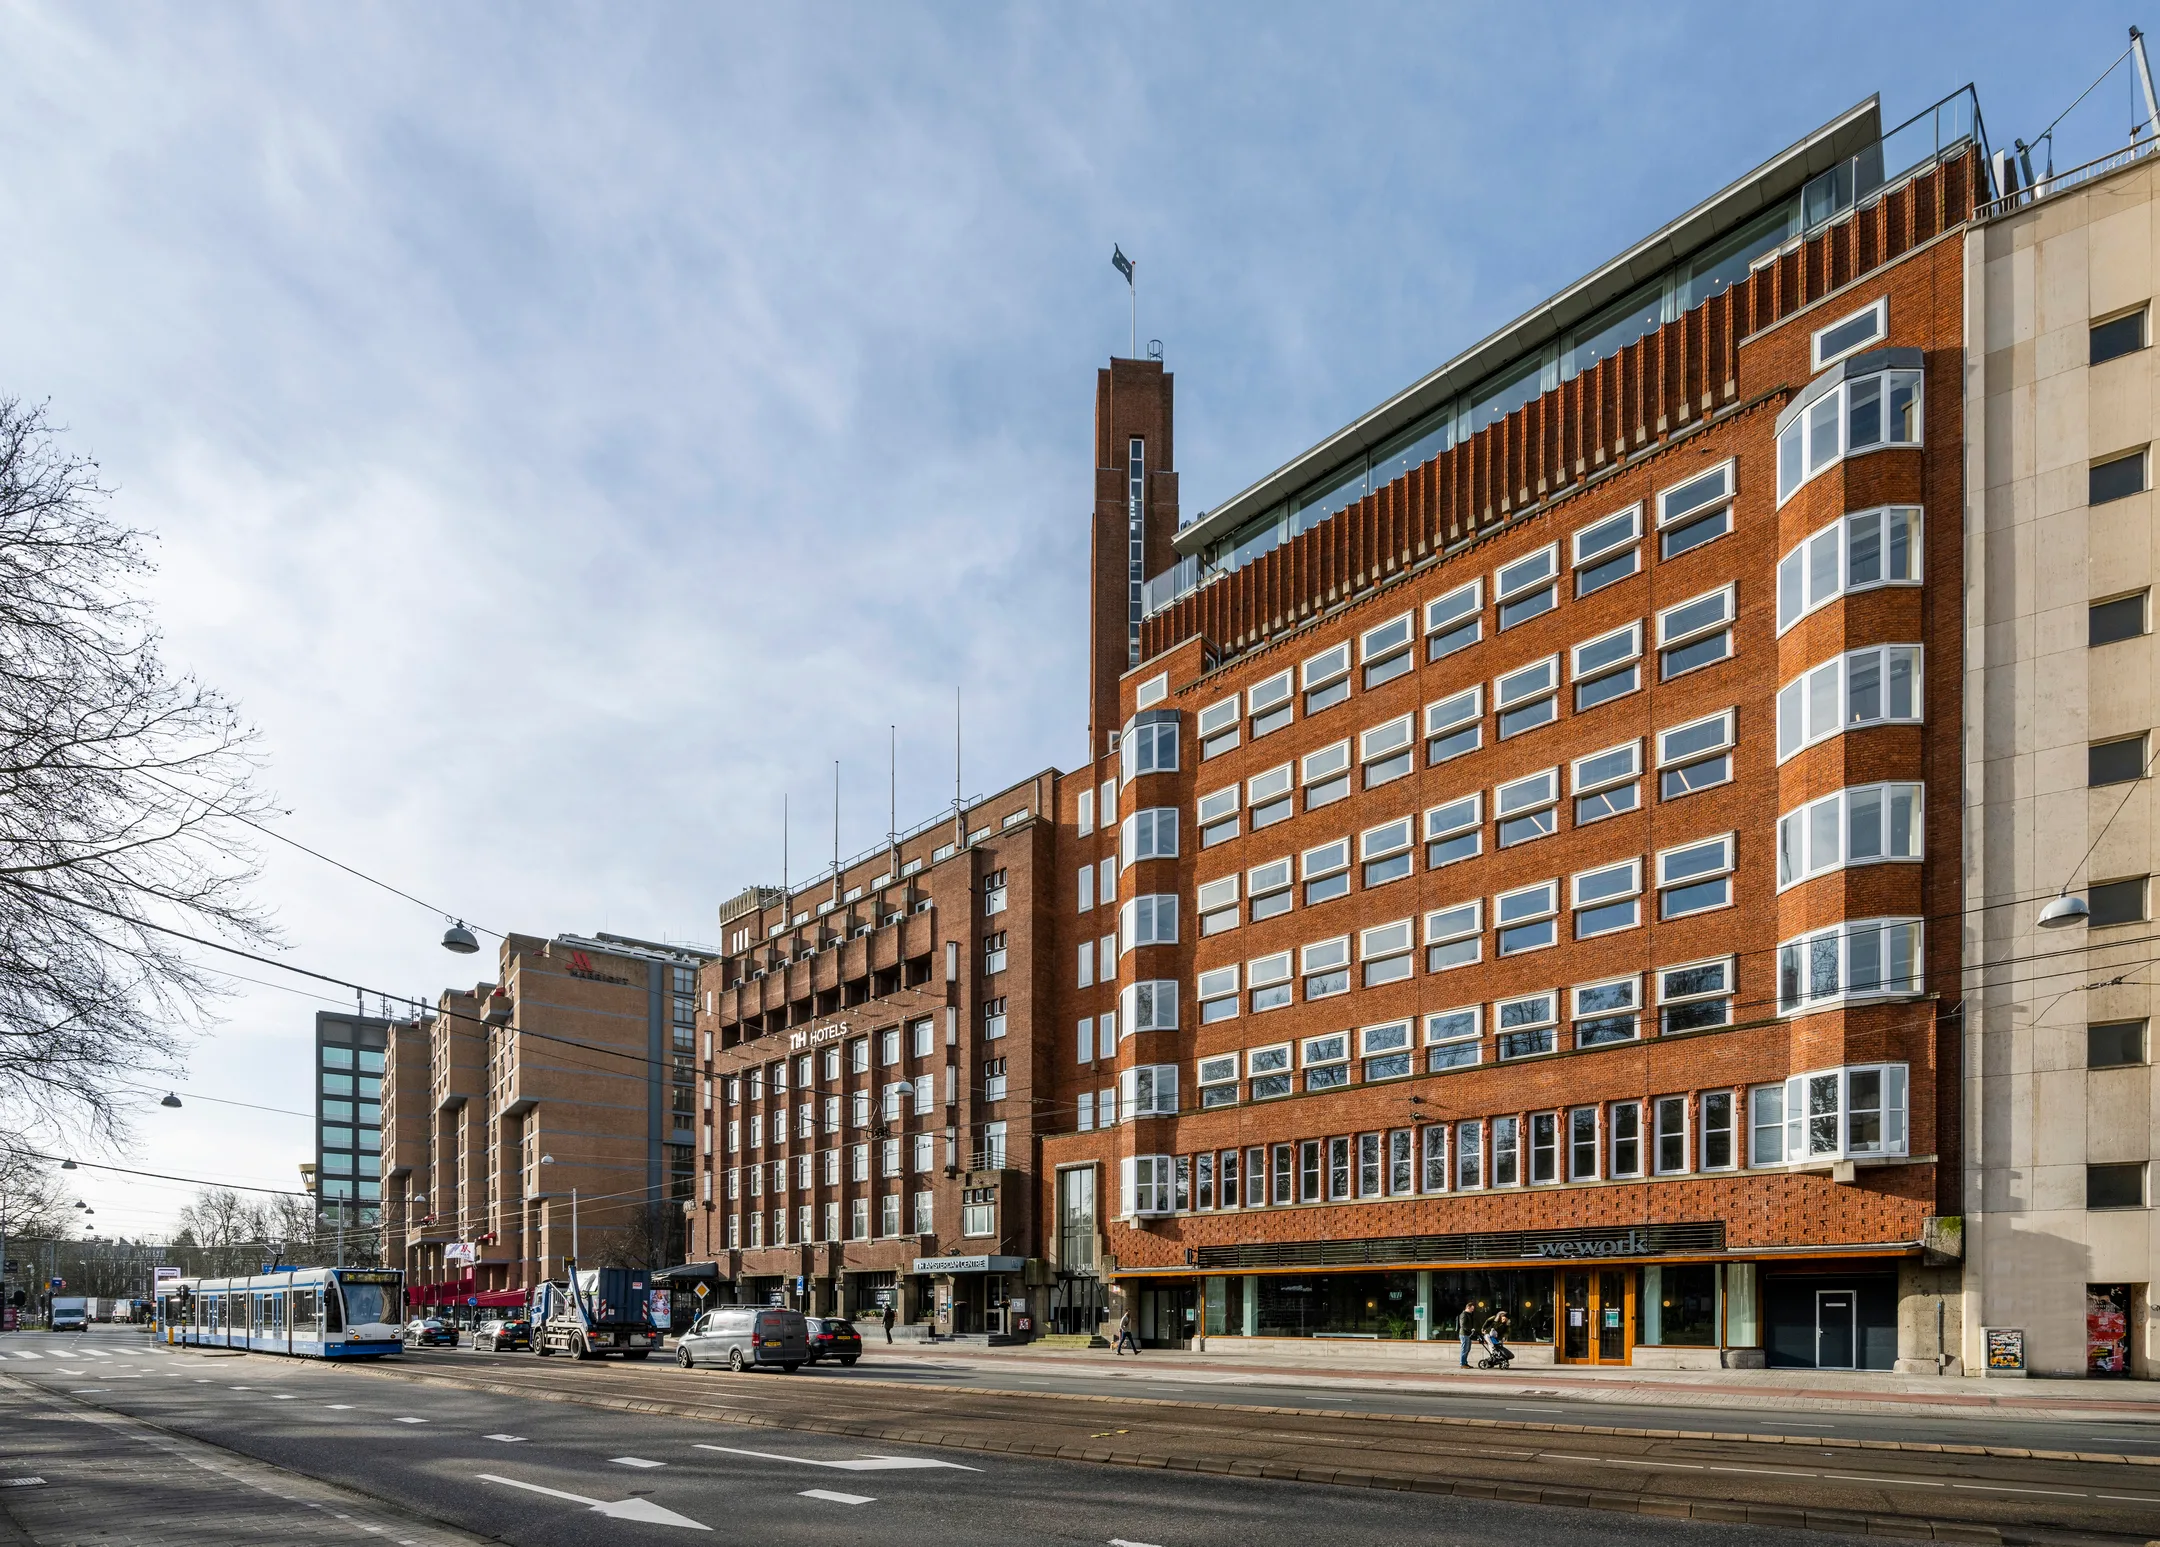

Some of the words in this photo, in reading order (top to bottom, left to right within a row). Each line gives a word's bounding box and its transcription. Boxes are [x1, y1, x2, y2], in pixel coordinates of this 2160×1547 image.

[570, 970, 629, 985] MARRIOTT
[810, 1021, 847, 1046] HOTELS
[1536, 1229, 1650, 1257] wework
[926, 1260, 962, 1270] AMSTERDAM
[962, 1259, 986, 1268] CENTRE
